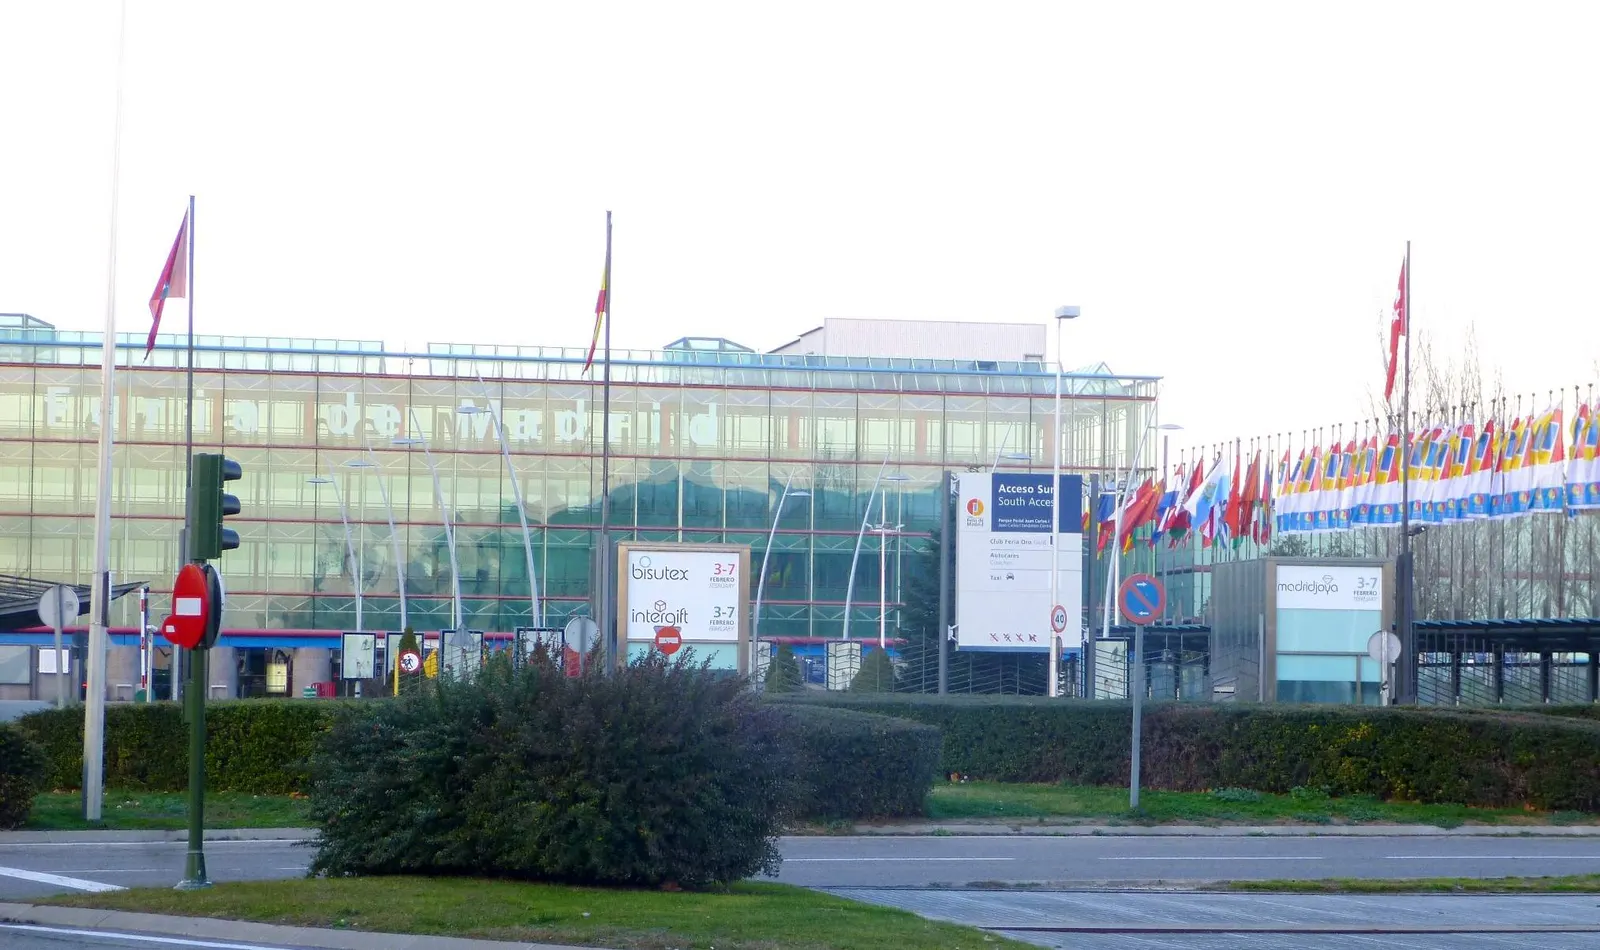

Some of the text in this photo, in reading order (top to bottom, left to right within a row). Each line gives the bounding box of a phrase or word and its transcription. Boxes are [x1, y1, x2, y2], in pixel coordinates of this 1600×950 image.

[998, 484, 1034, 494] Acceso
[998, 497, 1055, 507] South Acces
[632, 560, 689, 581] bisutex
[713, 563, 736, 575] 3-7
[1277, 580, 1339, 595] madridjoya
[1357, 577, 1378, 589] 3-7
[631, 607, 689, 627] intergift
[713, 606, 735, 618] 3-7
[1055, 614, 1065, 624] 40
